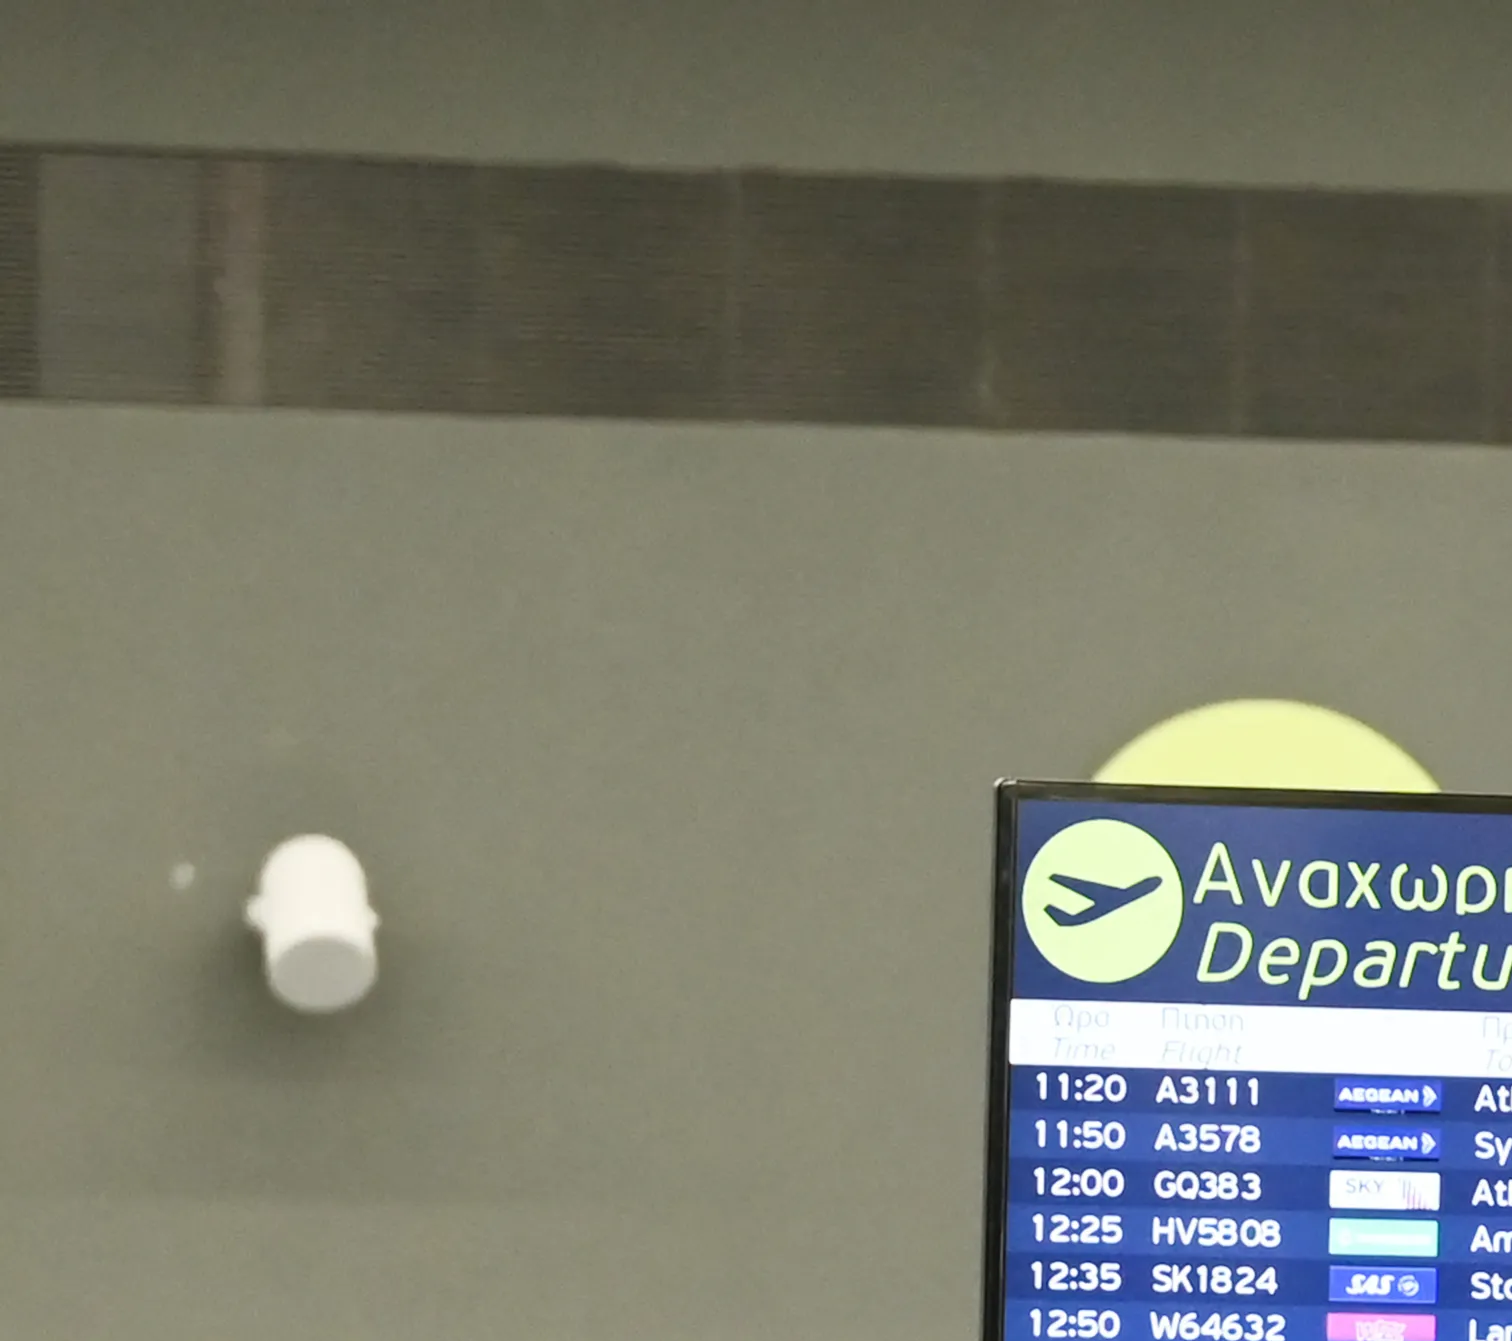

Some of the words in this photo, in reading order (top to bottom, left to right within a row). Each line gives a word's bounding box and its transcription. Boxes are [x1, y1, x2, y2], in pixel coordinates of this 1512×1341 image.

[1036, 1071, 1127, 1103] 11:20
[1155, 1075, 1259, 1106] A3111
[1338, 1086, 1420, 1104] AEGEAN
[1035, 1119, 1126, 1150] 11:50
[1154, 1123, 1261, 1154] A3578
[1336, 1134, 1419, 1151] AEGEAN
[1033, 1166, 1125, 1198] 12:00
[1153, 1170, 1262, 1201] GQ383
[1031, 1261, 1122, 1292] 12:35
[1152, 1263, 1279, 1295] SK1824
